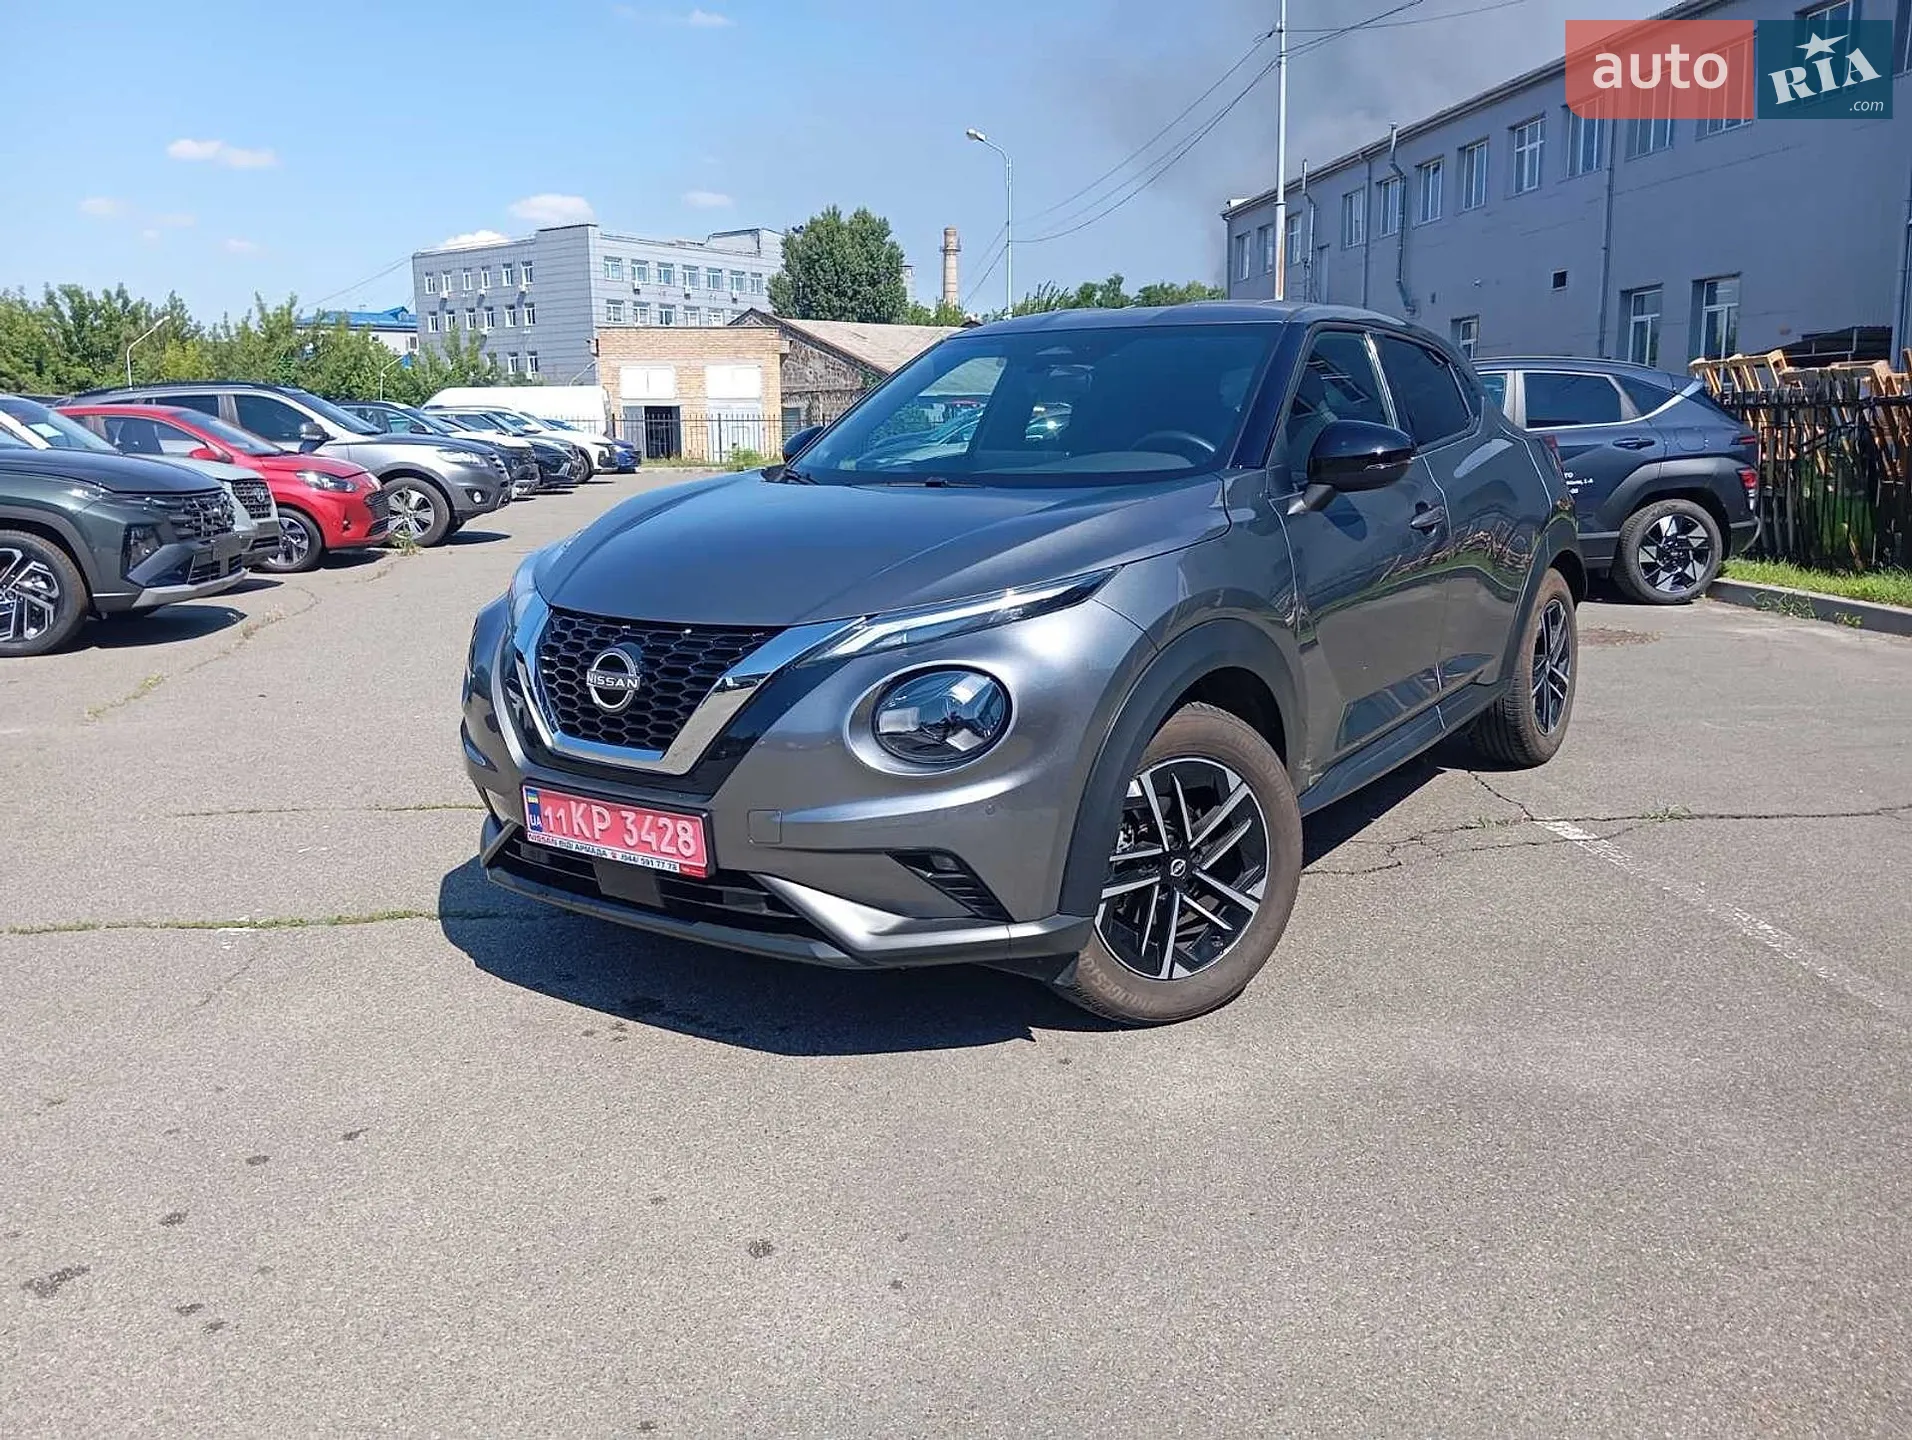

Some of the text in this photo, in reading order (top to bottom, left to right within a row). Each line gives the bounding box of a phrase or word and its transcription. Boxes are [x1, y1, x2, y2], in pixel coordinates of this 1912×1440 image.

[586, 671, 638, 688] NISSAN
[530, 814, 543, 827] UA
[544, 801, 696, 857] 11KP 3428
